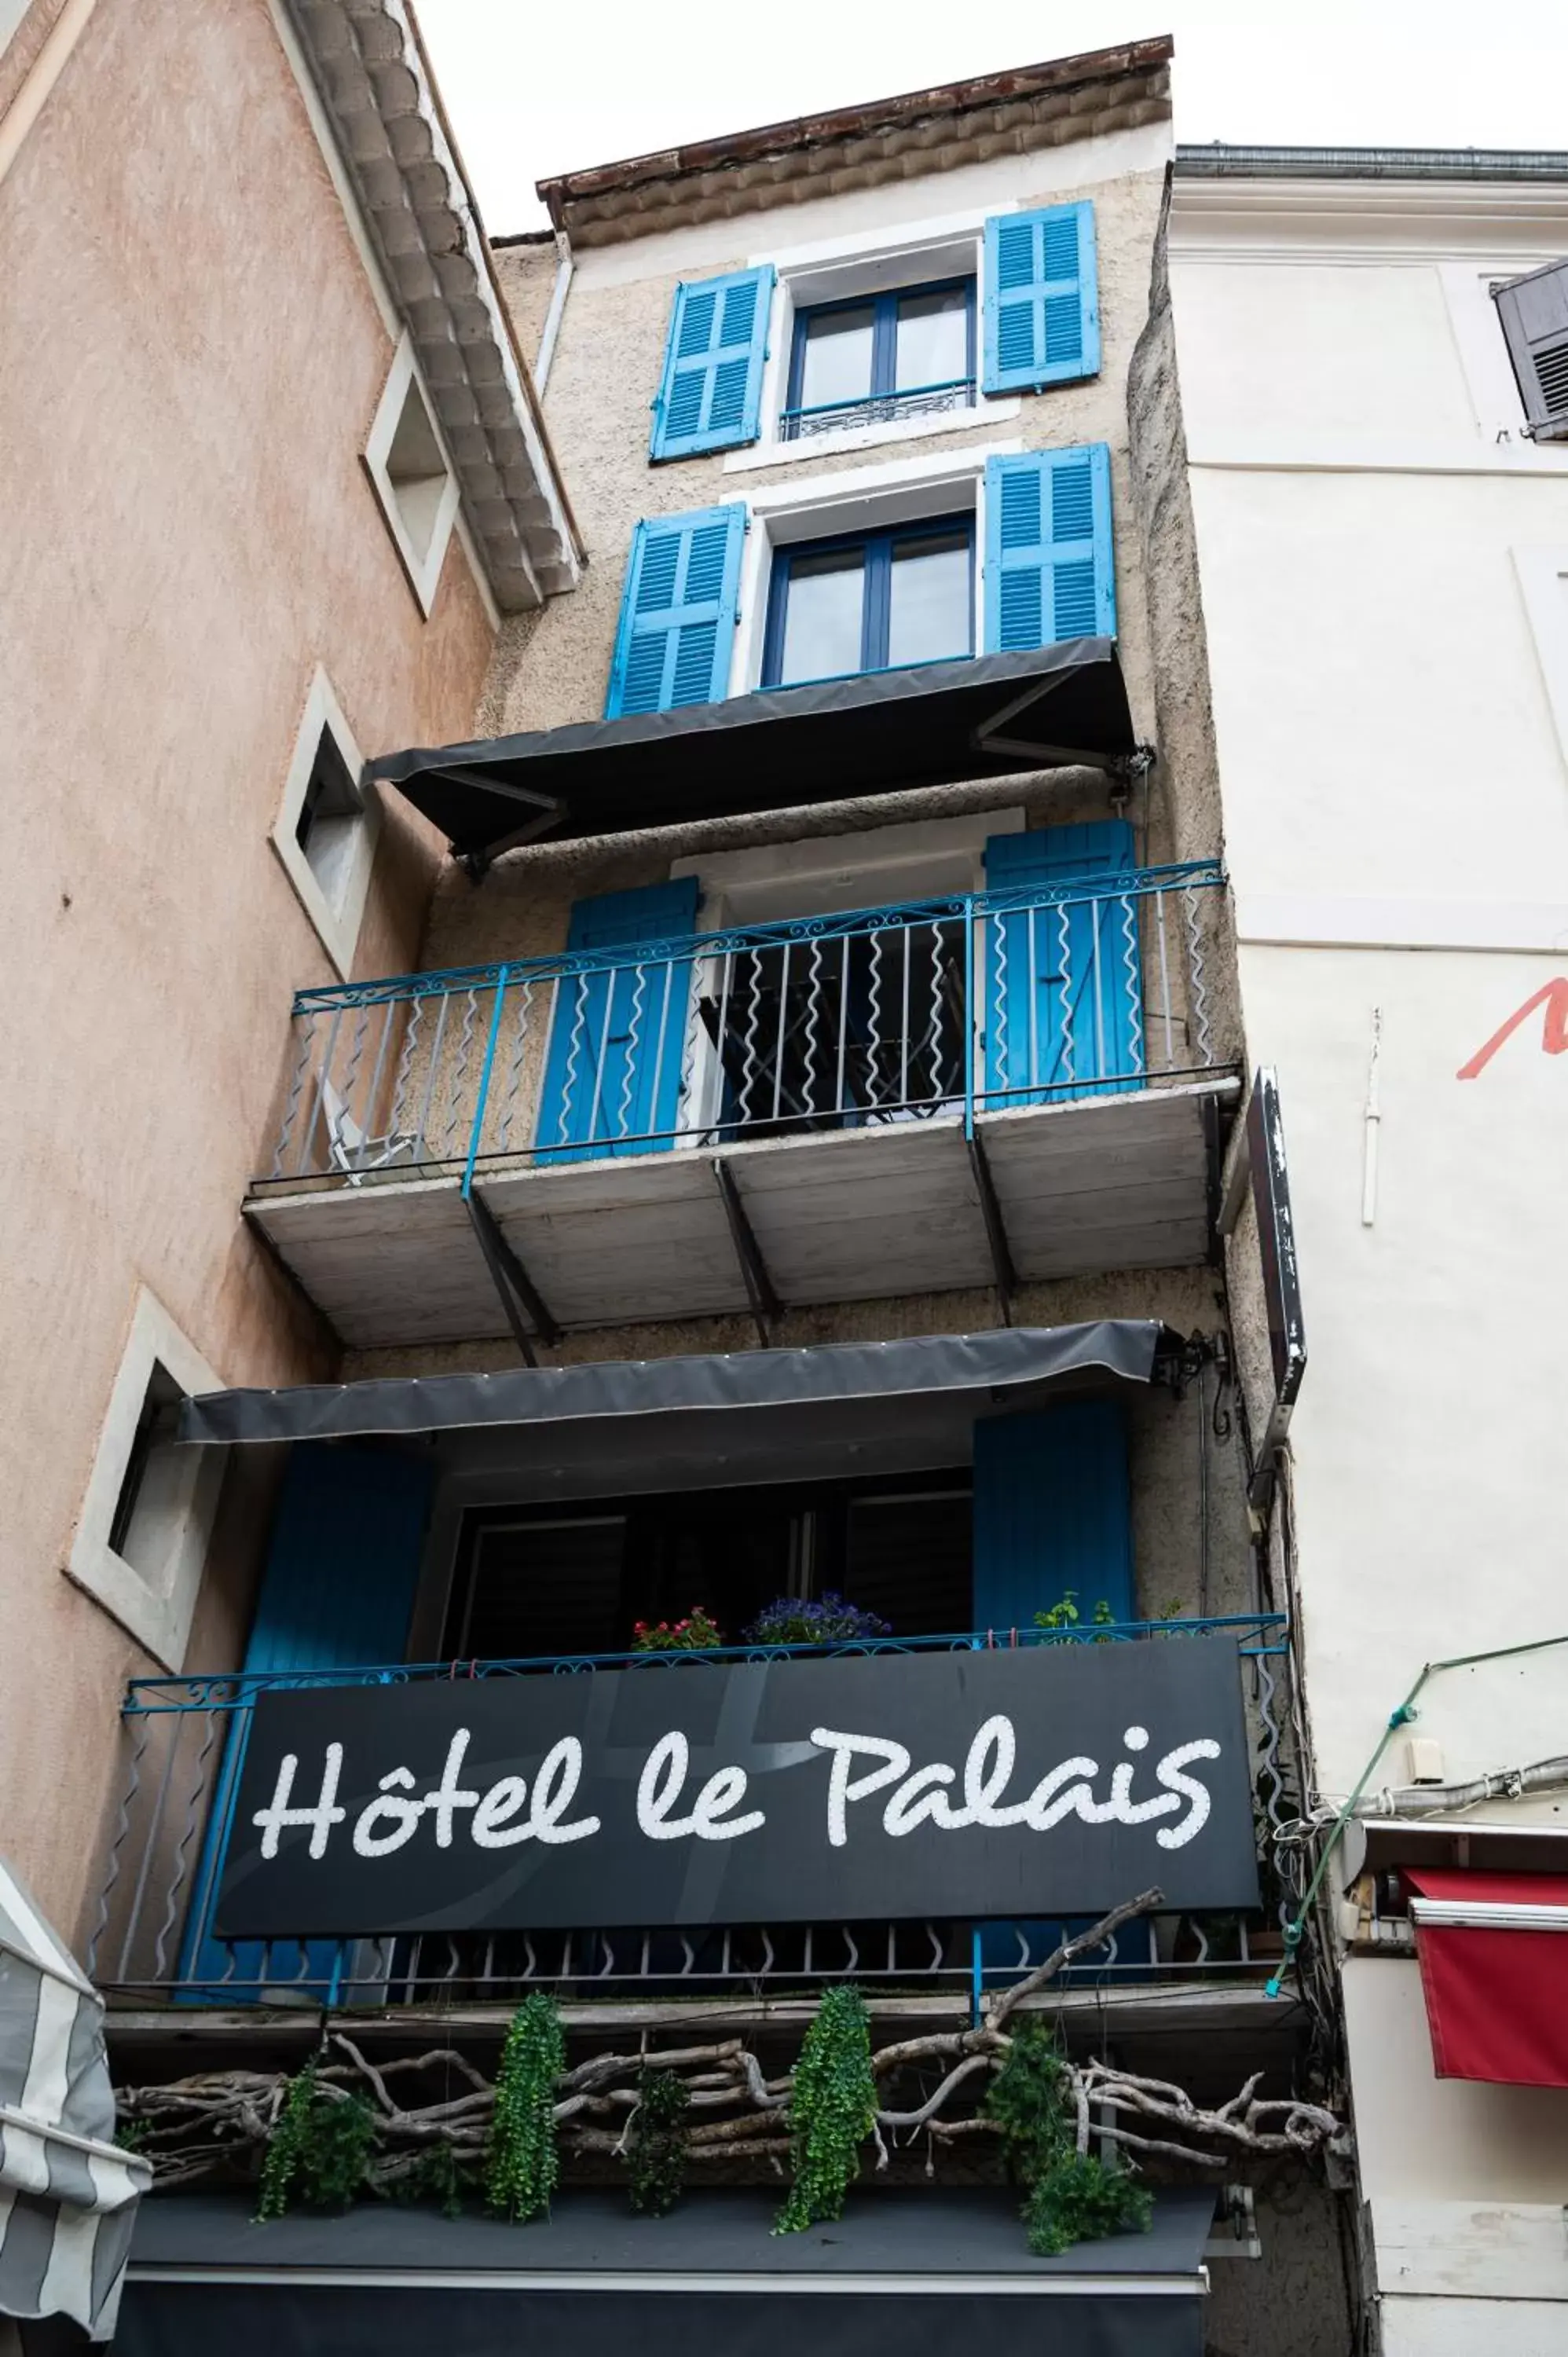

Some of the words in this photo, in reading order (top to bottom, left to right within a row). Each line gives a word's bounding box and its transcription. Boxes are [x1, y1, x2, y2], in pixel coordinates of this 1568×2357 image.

[252, 1728, 601, 1860] Hôtel
[636, 1730, 767, 1841] le
[810, 1714, 1222, 1850] Palais
